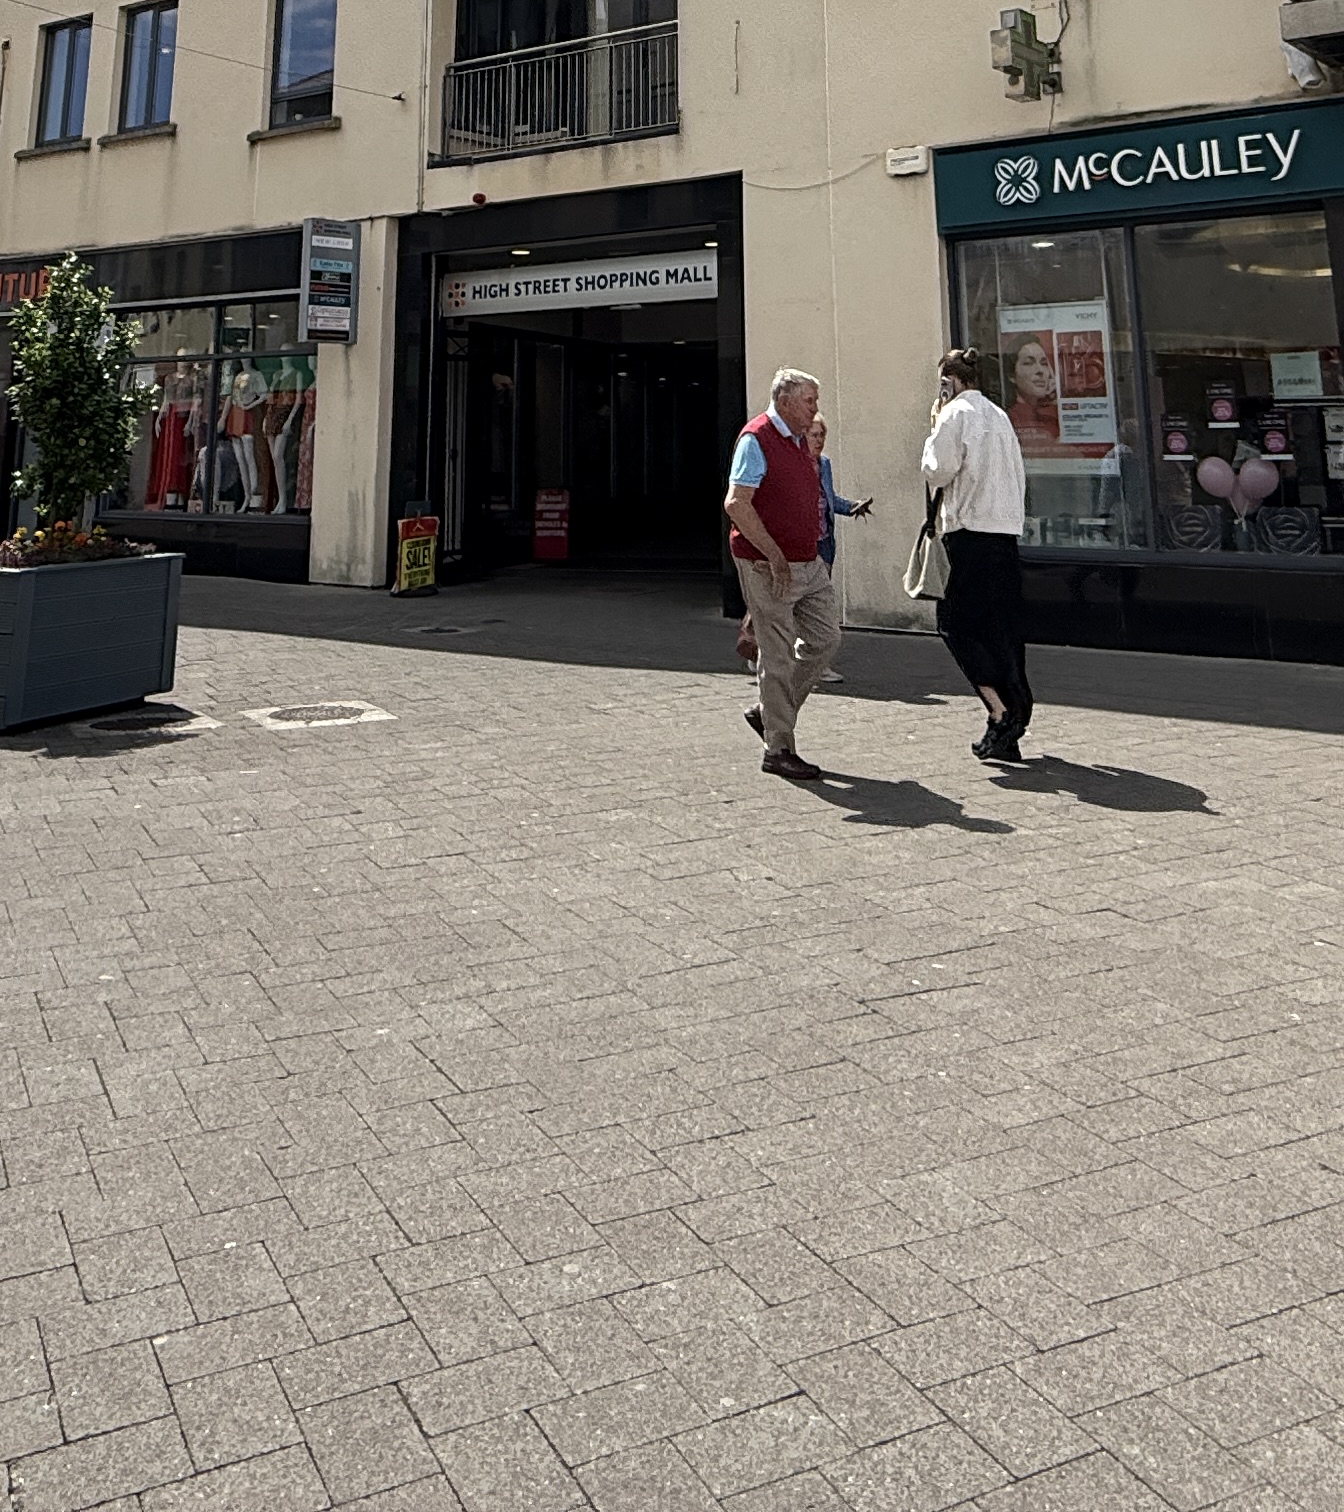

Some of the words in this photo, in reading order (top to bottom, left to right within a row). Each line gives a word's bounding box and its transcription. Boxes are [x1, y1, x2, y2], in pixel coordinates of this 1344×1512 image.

[472, 283, 511, 300] HIGH
[514, 277, 572, 297] STREET
[575, 269, 660, 292] SHOPPING
[665, 265, 713, 285] MALL
